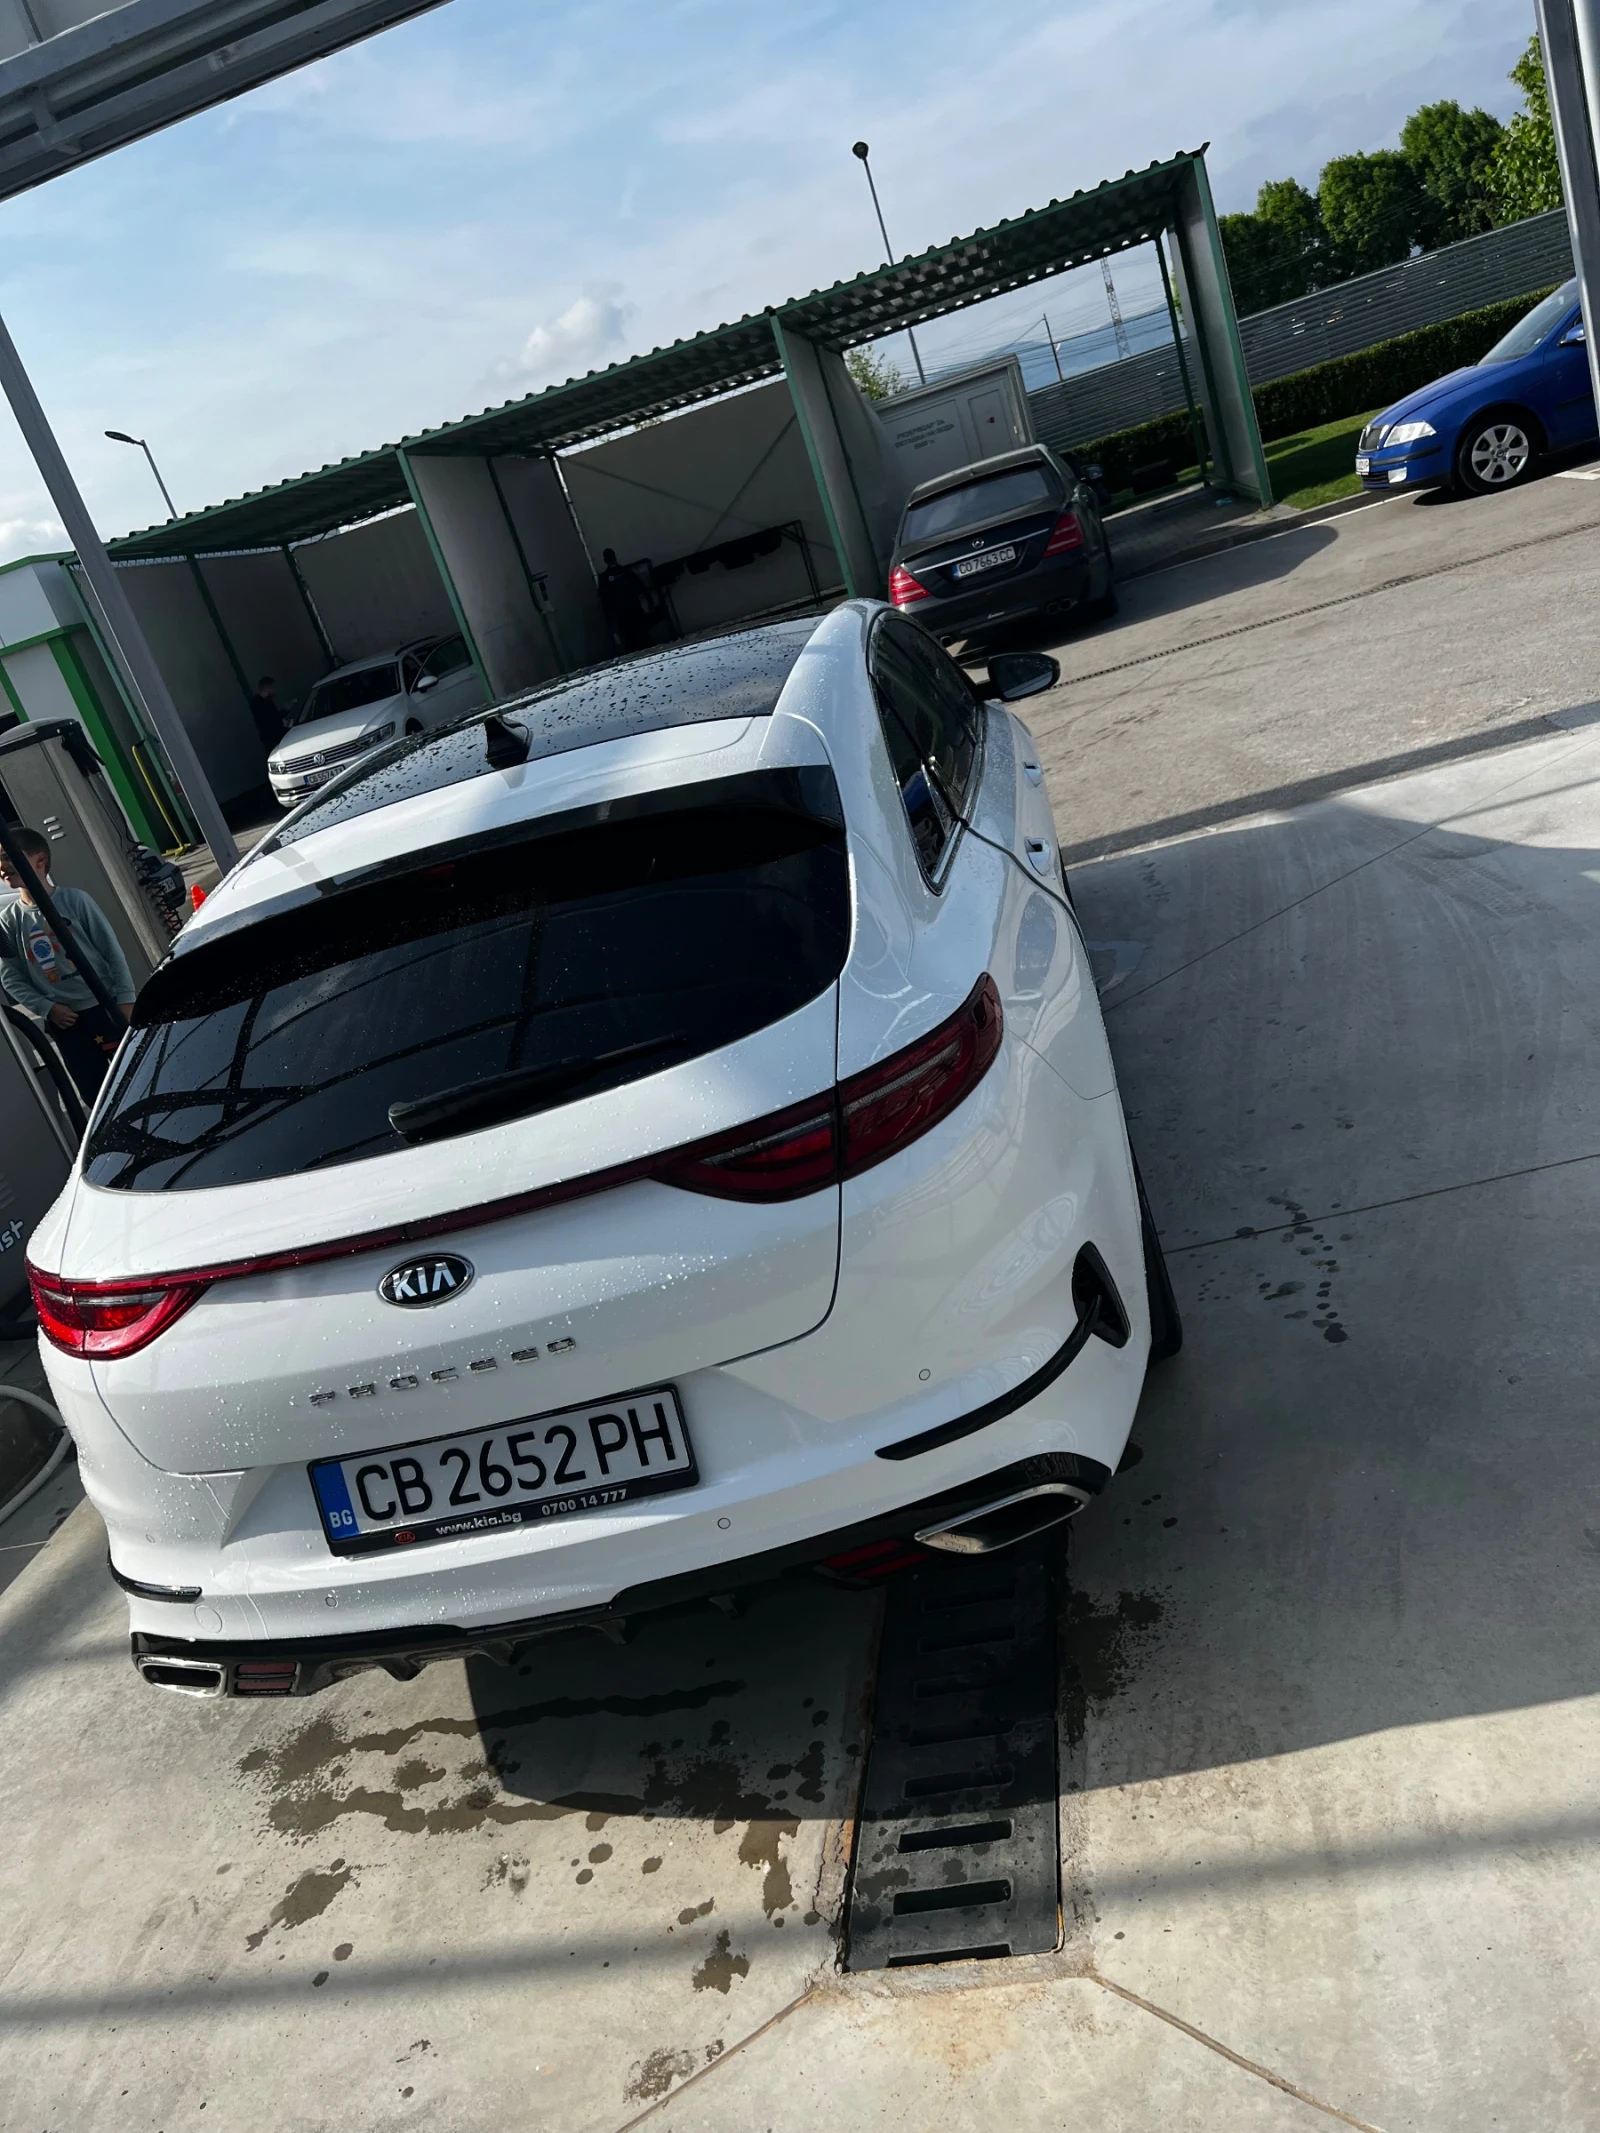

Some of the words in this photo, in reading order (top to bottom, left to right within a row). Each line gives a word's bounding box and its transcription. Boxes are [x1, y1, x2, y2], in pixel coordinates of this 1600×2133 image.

[973, 553, 999, 569] 7663
[999, 548, 1014, 561] CC
[392, 1262, 457, 1300] KIA
[308, 1336, 576, 1407] PROCEED
[355, 1457, 433, 1521] CB
[438, 1425, 587, 1506] 2652
[587, 1402, 677, 1475] PH
[329, 1509, 353, 1528] BG
[397, 1532, 414, 1543] KIA
[435, 1510, 522, 1535] www.kia.bg
[541, 1499, 576, 1517] 0700
[581, 1493, 598, 1509] 14
[599, 1488, 628, 1506] 777
